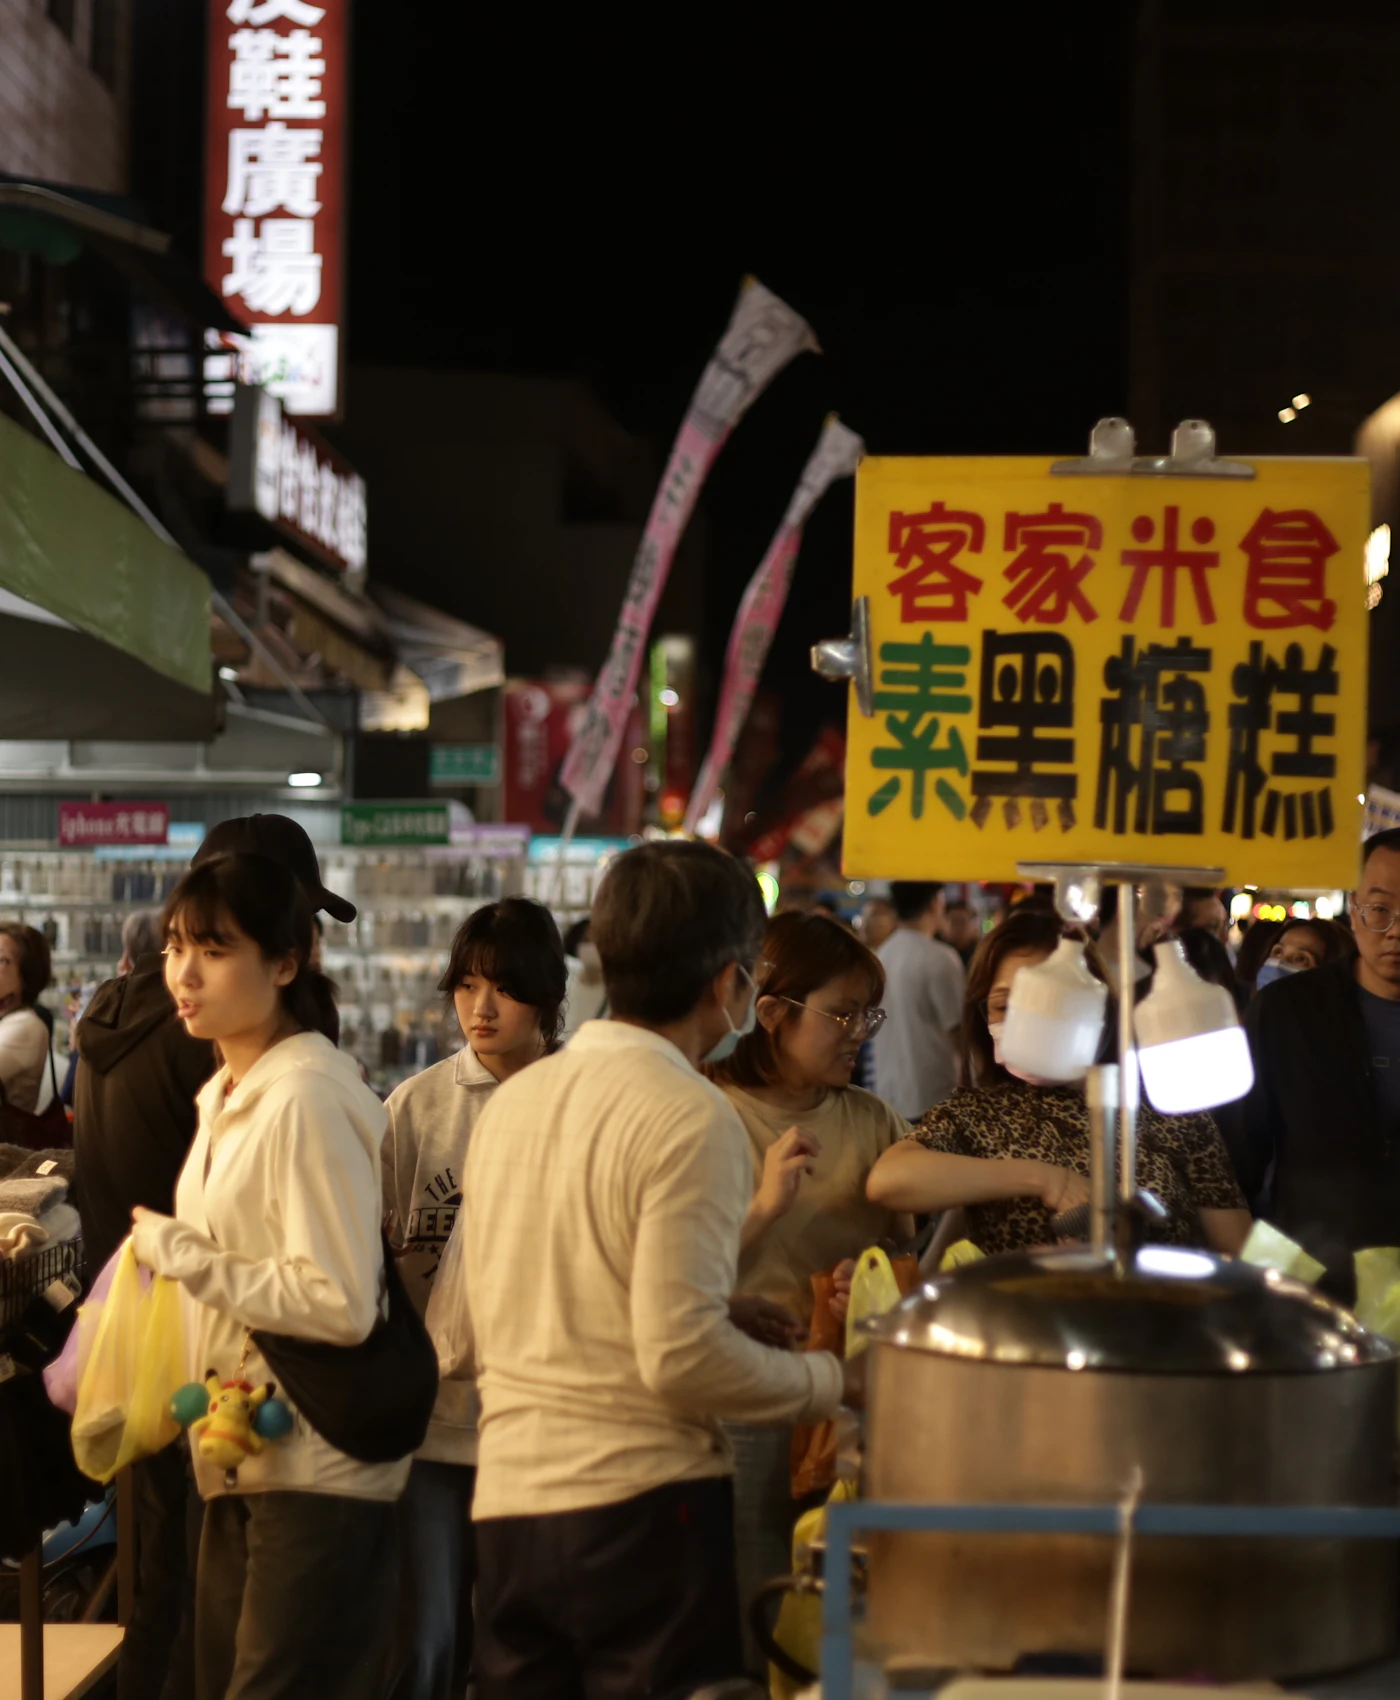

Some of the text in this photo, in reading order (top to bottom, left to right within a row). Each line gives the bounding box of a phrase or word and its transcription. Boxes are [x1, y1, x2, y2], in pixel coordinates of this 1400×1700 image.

[887, 502, 1339, 630] 客家米食
[867, 630, 1339, 840] 素黑糖糕
[424, 1168, 457, 1201] THE
